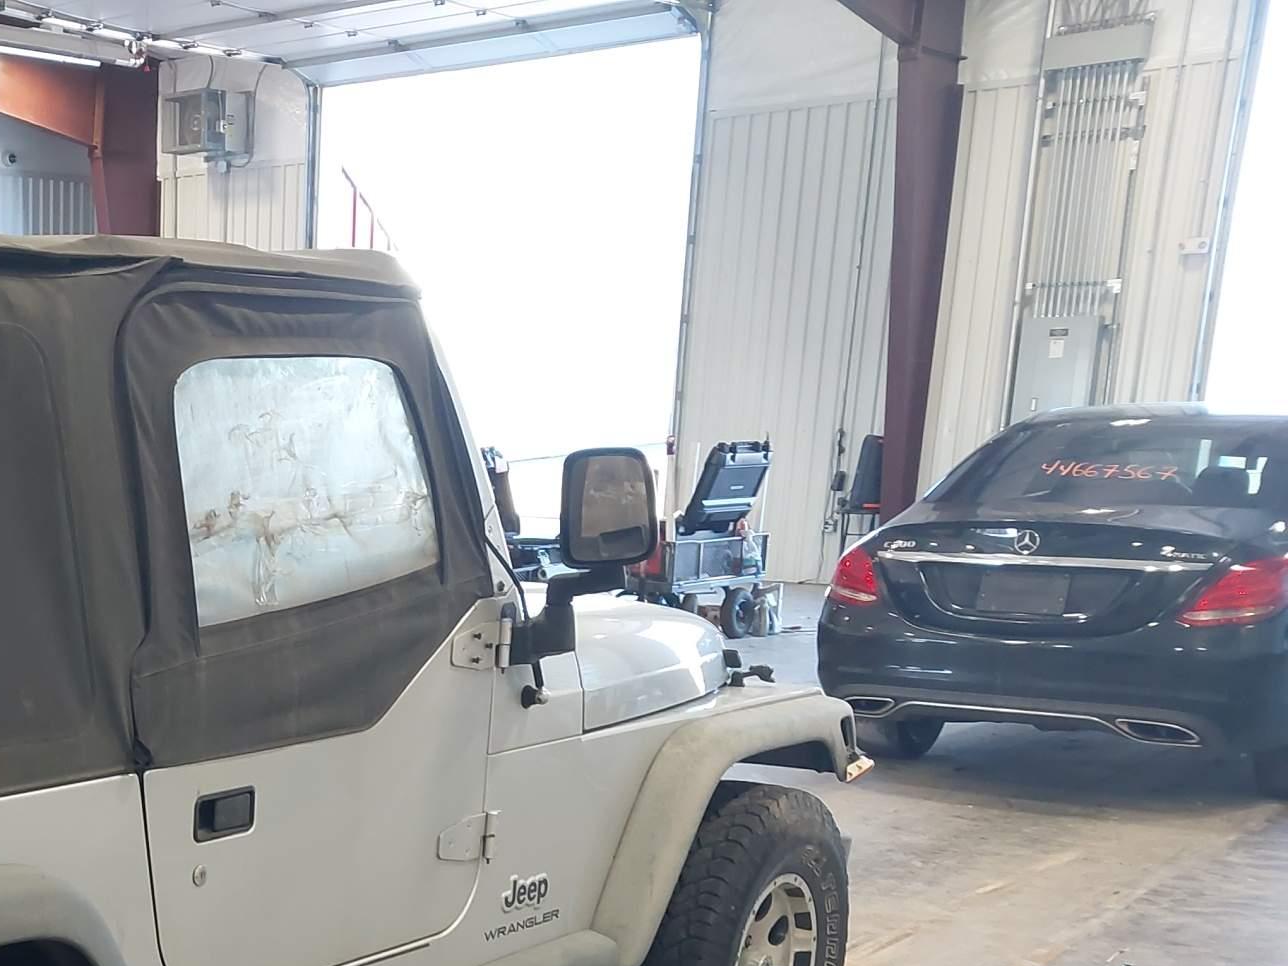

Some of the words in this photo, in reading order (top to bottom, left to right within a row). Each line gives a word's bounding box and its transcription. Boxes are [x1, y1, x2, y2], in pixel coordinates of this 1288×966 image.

[1040, 459, 1179, 481] 44667567
[502, 873, 549, 908] Jeep
[484, 909, 560, 941] WRANGLER
